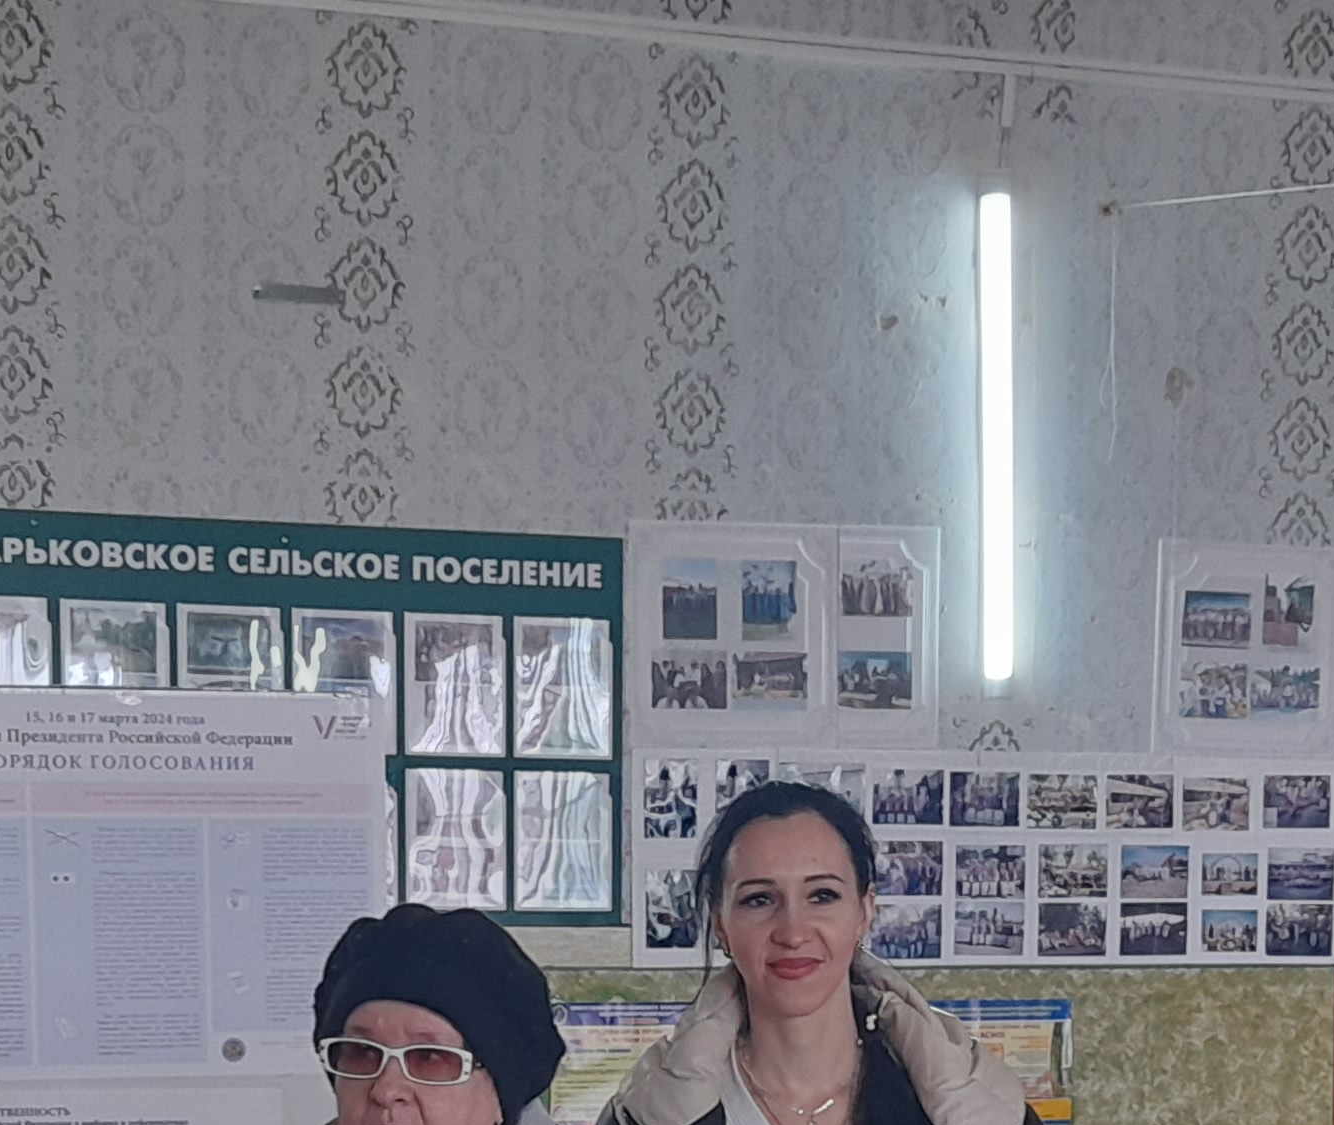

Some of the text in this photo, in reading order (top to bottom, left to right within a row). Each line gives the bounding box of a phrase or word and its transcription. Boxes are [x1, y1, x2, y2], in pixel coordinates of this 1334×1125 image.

[227, 546, 401, 580] СЕЛЬСКОЕ
[412, 555, 603, 589] ПОСЕЛЕНИЕ
[25, 711, 206, 727] 15, 16 и 17 марта 2024 года
[6, 728, 104, 747] Президента
[108, 729, 202, 745] Российской
[205, 730, 294, 748] Федерации
[90, 754, 255, 771] ГОЛОСОВАНИЯ
